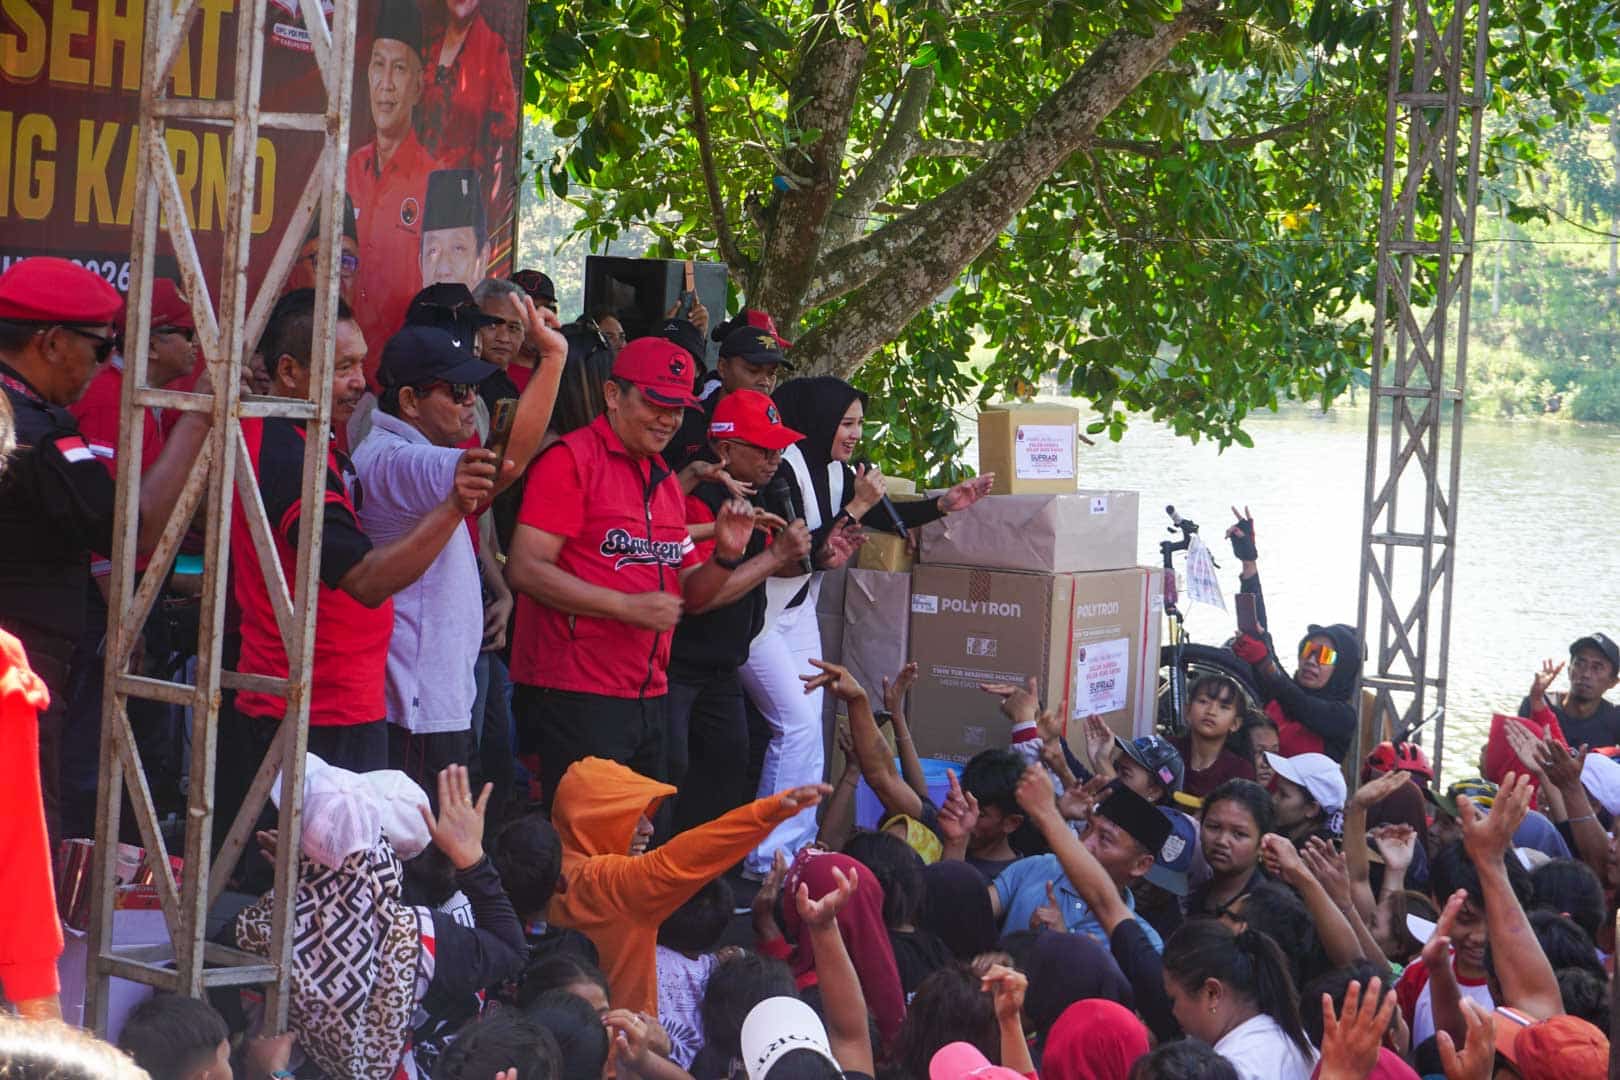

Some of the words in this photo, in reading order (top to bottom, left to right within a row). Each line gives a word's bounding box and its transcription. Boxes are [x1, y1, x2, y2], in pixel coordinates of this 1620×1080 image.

[72, 258, 130, 292] 26
[942, 598, 1021, 618] POLYTRON
[1077, 600, 1120, 618] POLYTRON
